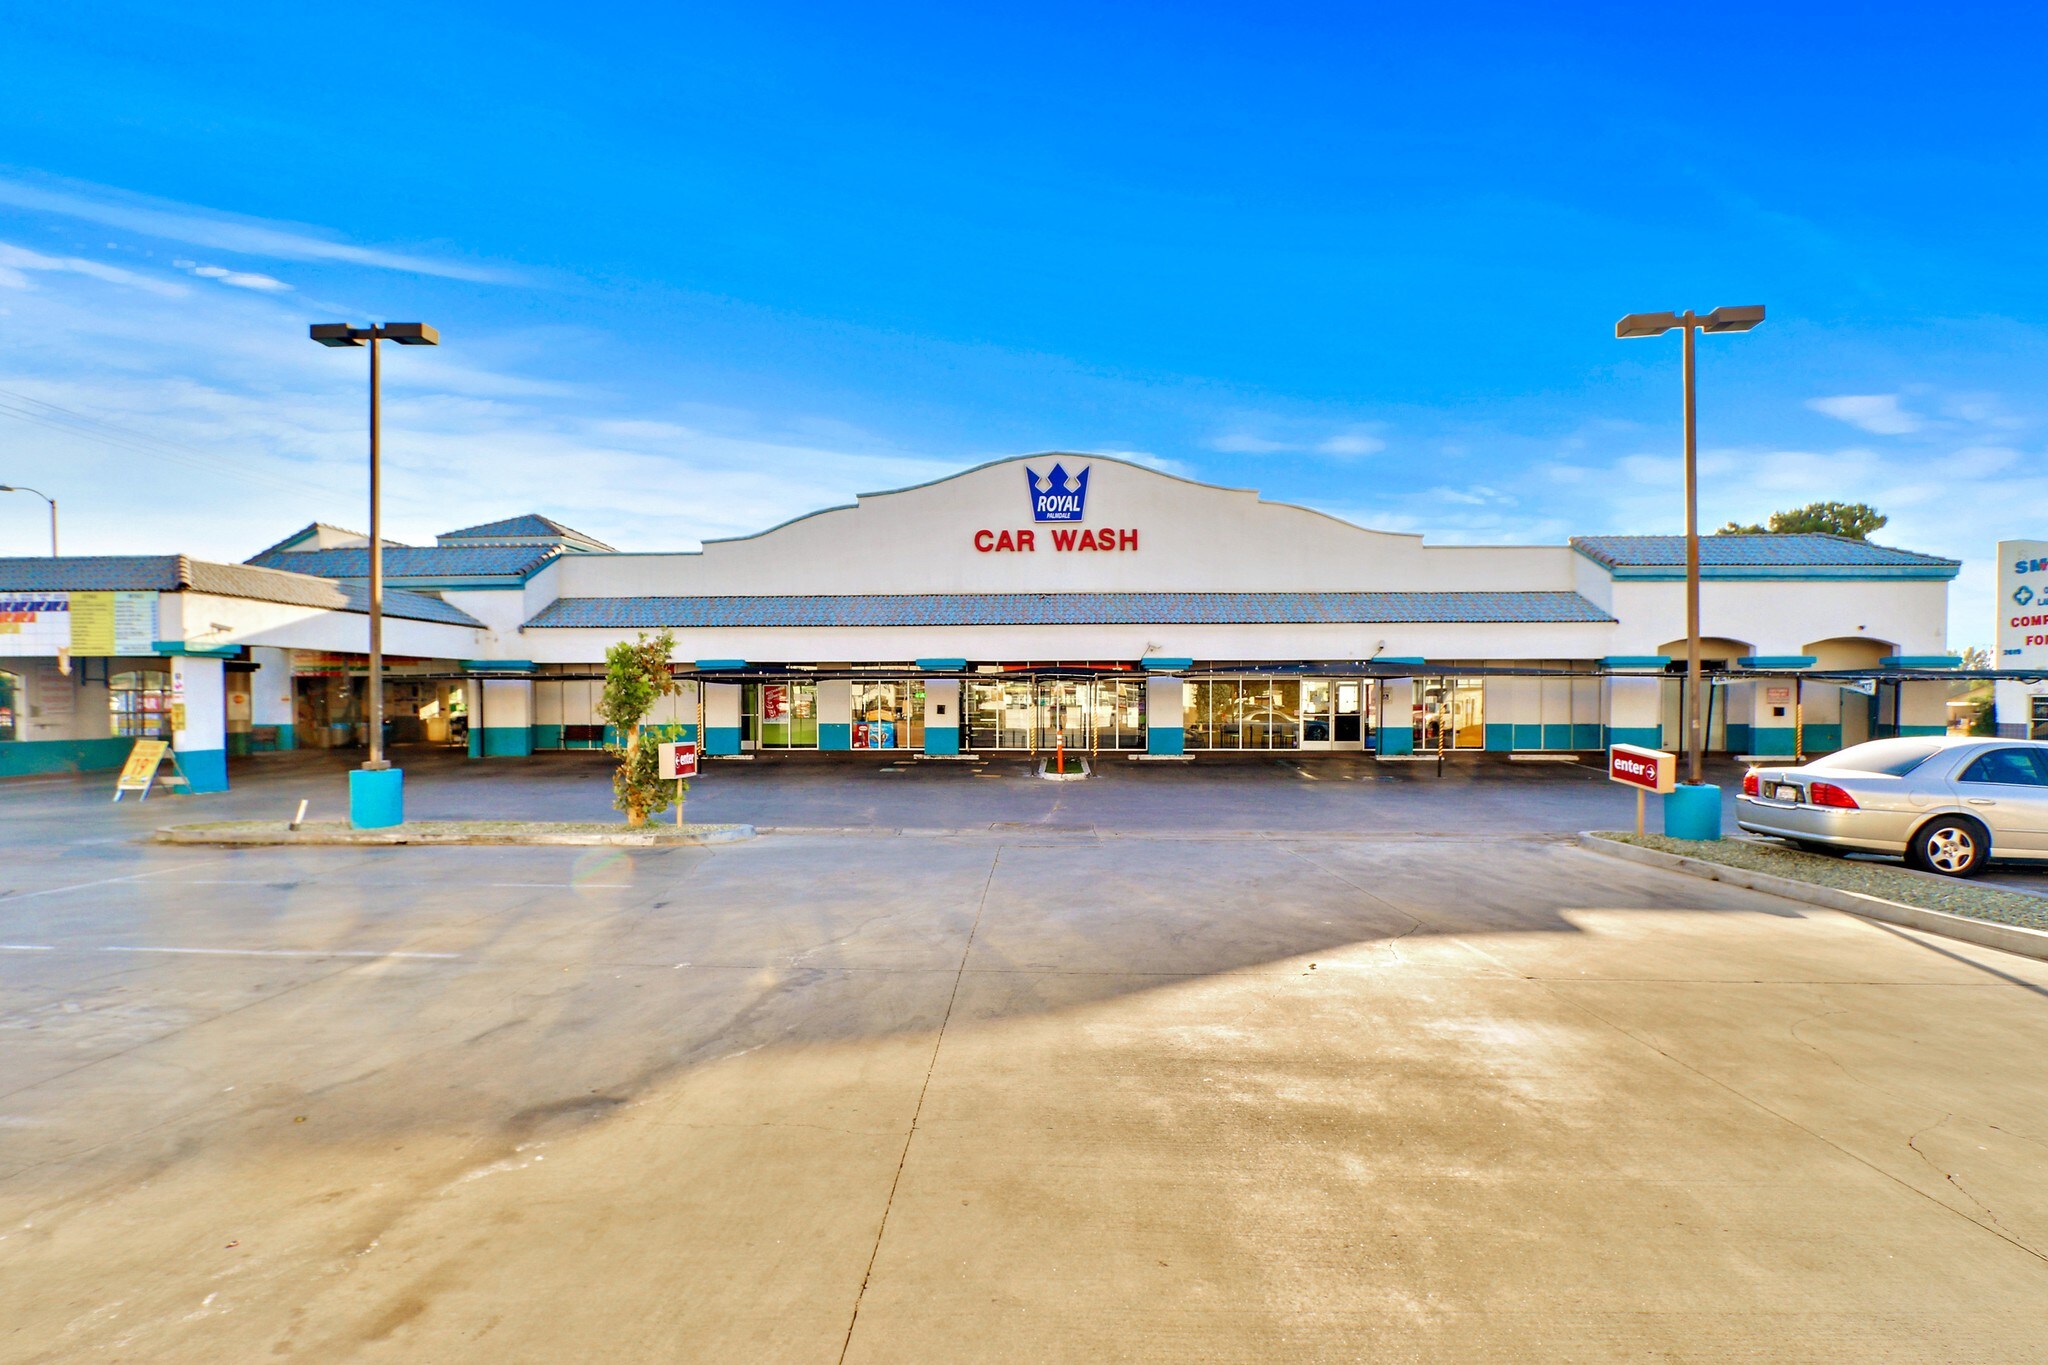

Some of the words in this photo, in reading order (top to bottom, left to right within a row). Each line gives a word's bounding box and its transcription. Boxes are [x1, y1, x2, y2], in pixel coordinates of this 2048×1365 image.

[1037, 495, 1081, 512] ROYAL
[974, 529, 1035, 552] CAR
[1051, 528, 1138, 551] WASH
[680, 752, 695, 766] enter
[1614, 758, 1645, 776] enter
